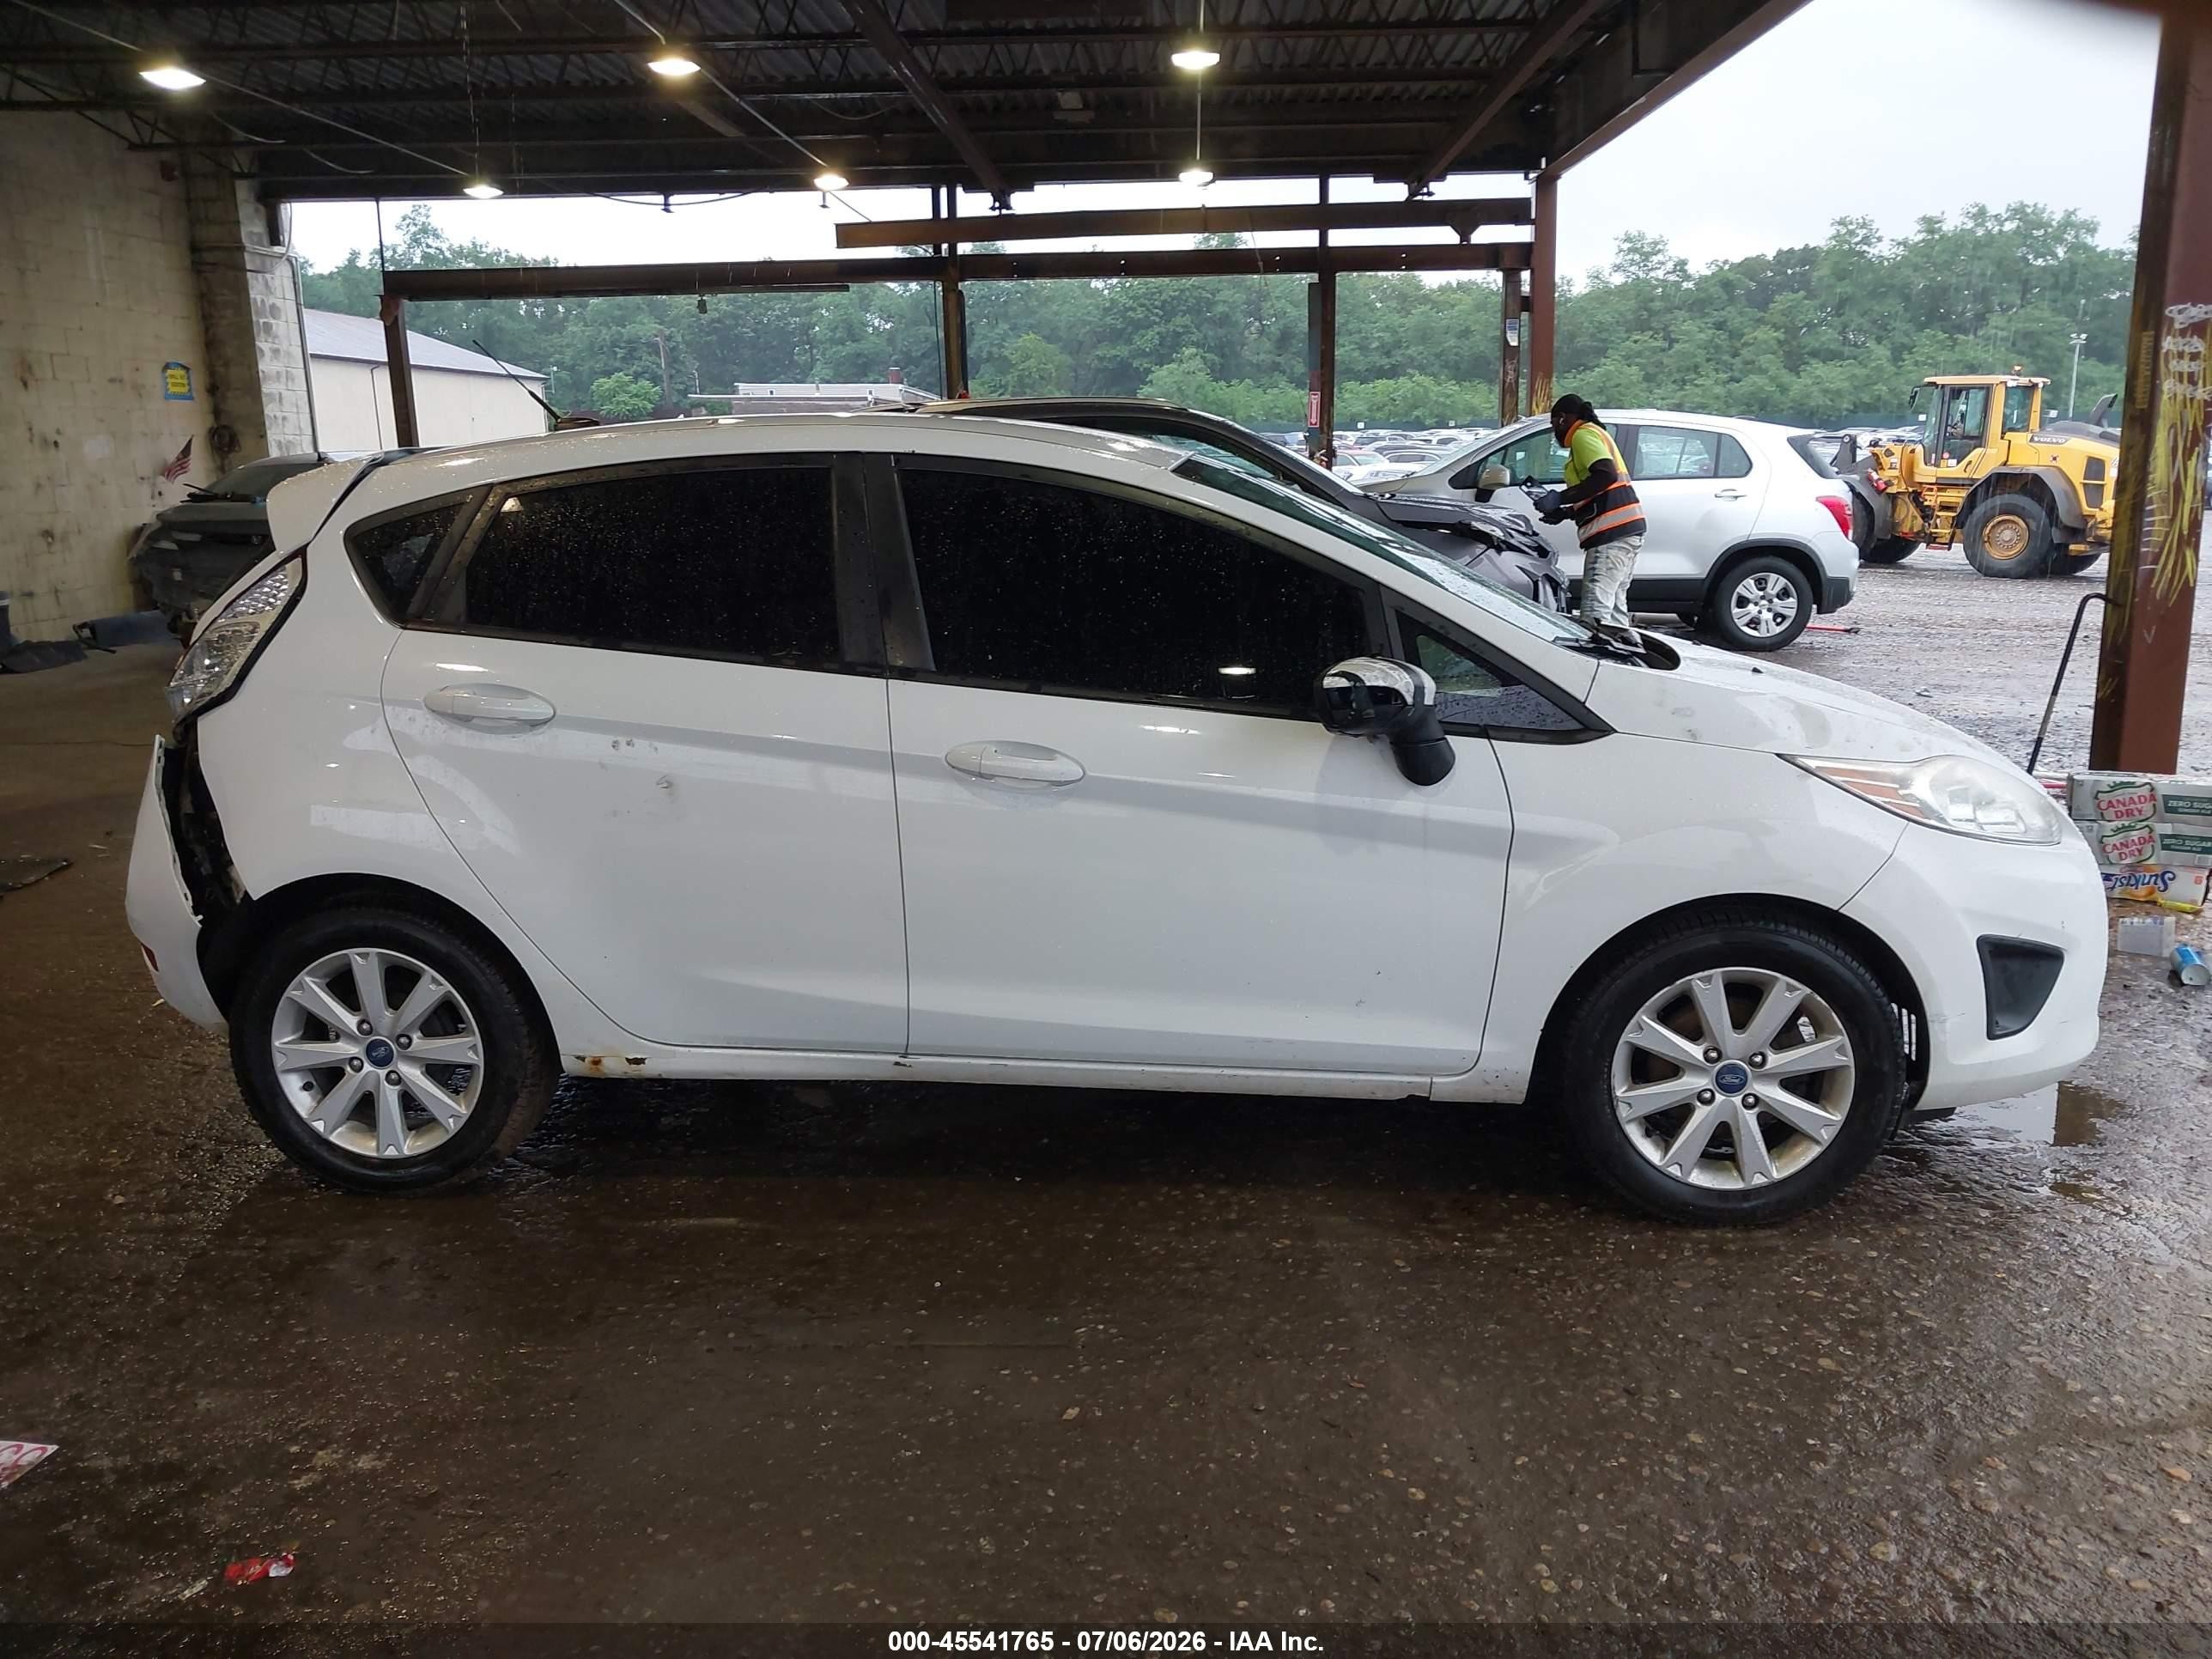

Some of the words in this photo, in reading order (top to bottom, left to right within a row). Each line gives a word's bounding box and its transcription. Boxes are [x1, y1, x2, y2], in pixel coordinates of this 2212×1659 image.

[2096, 793, 2157, 811] CANADA
[2167, 799, 2191, 808] ZERO
[2114, 806, 2144, 819] DRY
[2102, 835, 2155, 854] CANADA
[2118, 846, 2144, 861] DRY
[2106, 870, 2176, 893] Sunkist
